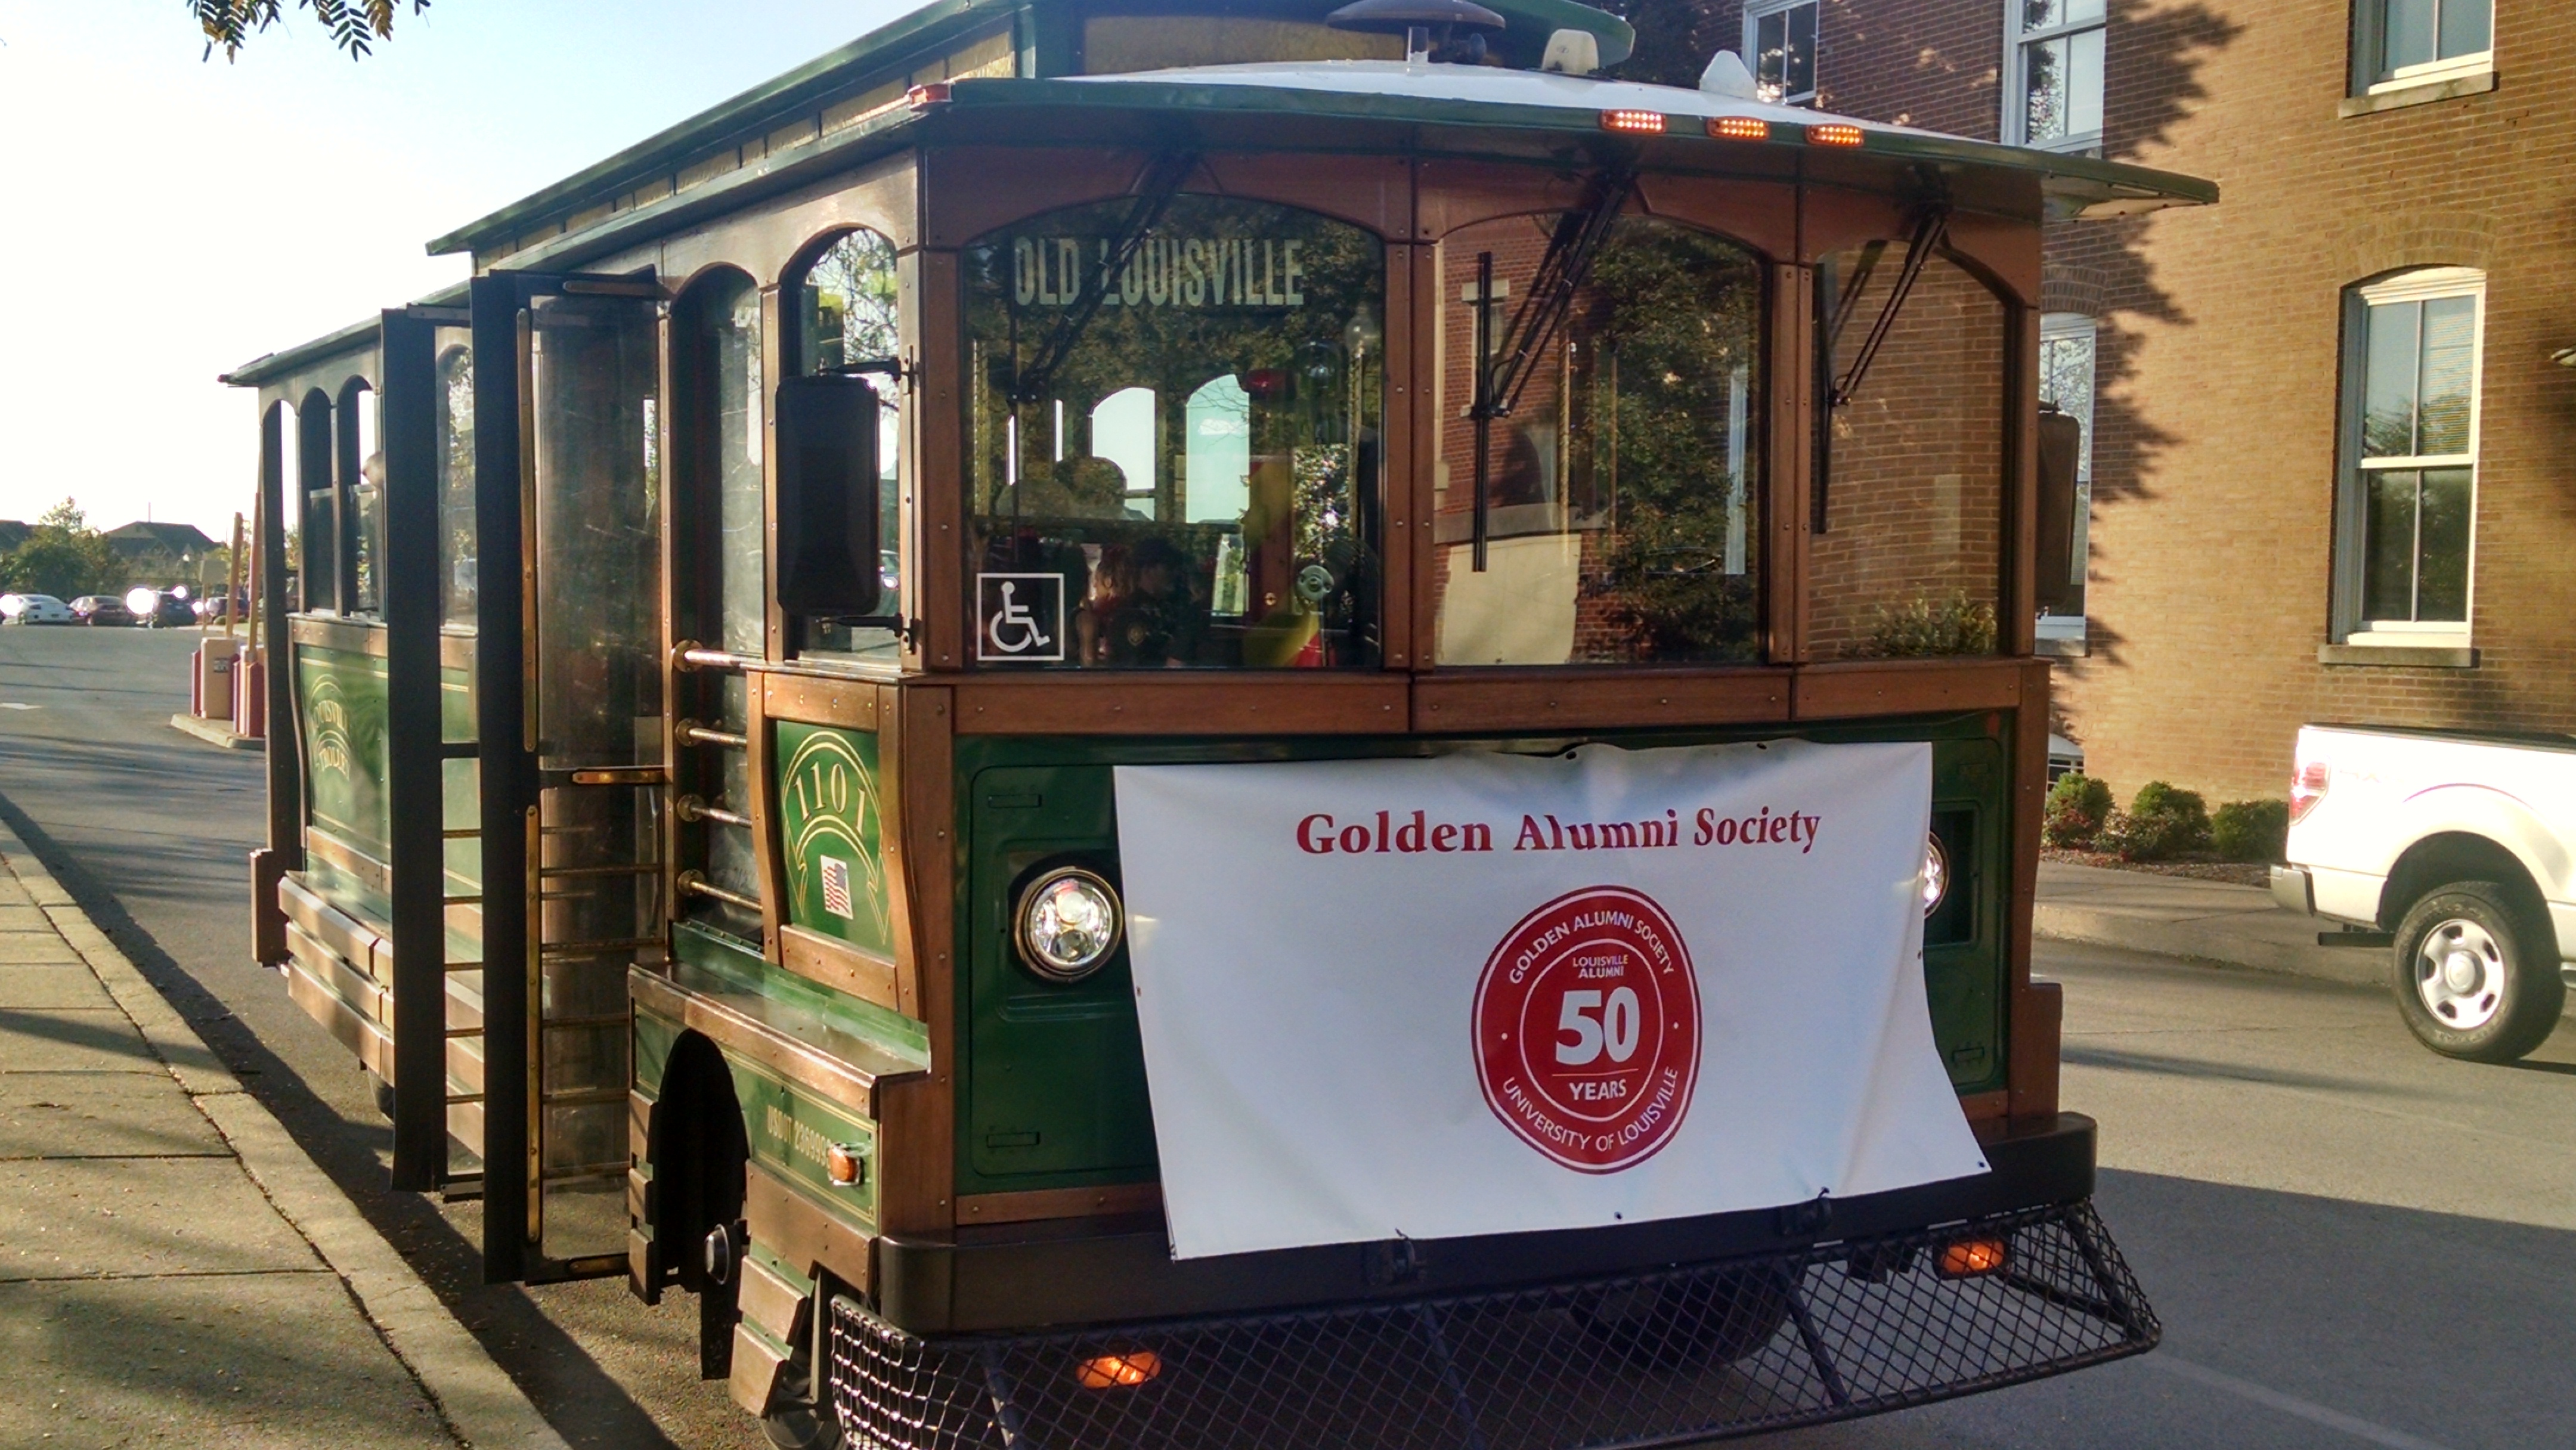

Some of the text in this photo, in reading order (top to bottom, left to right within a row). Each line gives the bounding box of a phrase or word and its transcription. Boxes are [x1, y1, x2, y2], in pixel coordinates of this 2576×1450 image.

[1015, 237, 1304, 306] OLD LOUISVILLE
[793, 761, 866, 836] 1101
[1296, 806, 1821, 854] Golden Alumni Society
[1509, 910, 1674, 984] GOLDEN ALUMNI SOCIETY
[1573, 955, 1628, 967] LOUISVILLE
[1578, 966, 1624, 978] ALUMNI
[1555, 986, 1640, 1065] 50
[1503, 1066, 1678, 1152] UNIVERSITY OF LOUISVILLE
[1569, 1079, 1627, 1101] YEARS
